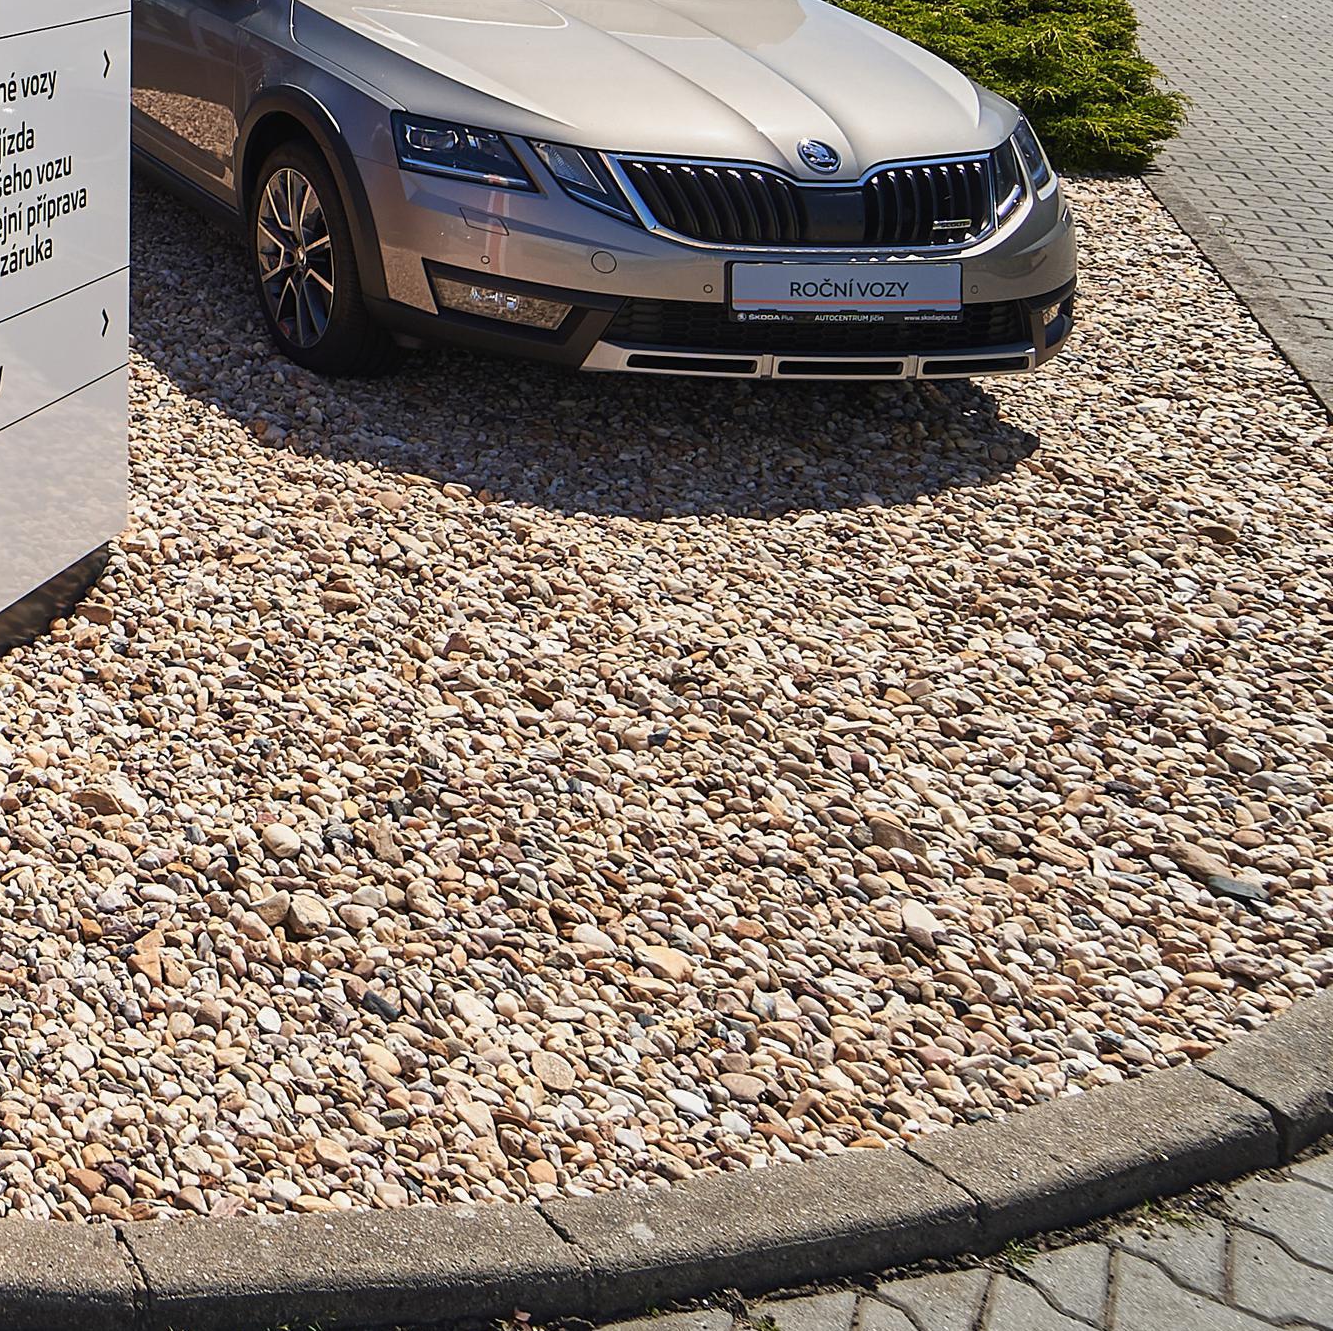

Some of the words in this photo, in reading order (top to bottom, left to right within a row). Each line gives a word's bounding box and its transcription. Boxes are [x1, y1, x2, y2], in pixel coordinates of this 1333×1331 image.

[20, 70, 57, 100] vozy
[36, 155, 72, 185] vozu
[27, 187, 87, 236] příprava
[0, 233, 53, 278] záruka
[789, 278, 854, 298] ROČNÍ
[857, 281, 910, 298] VOZY
[814, 314, 869, 322] AUTOCENTRUM
